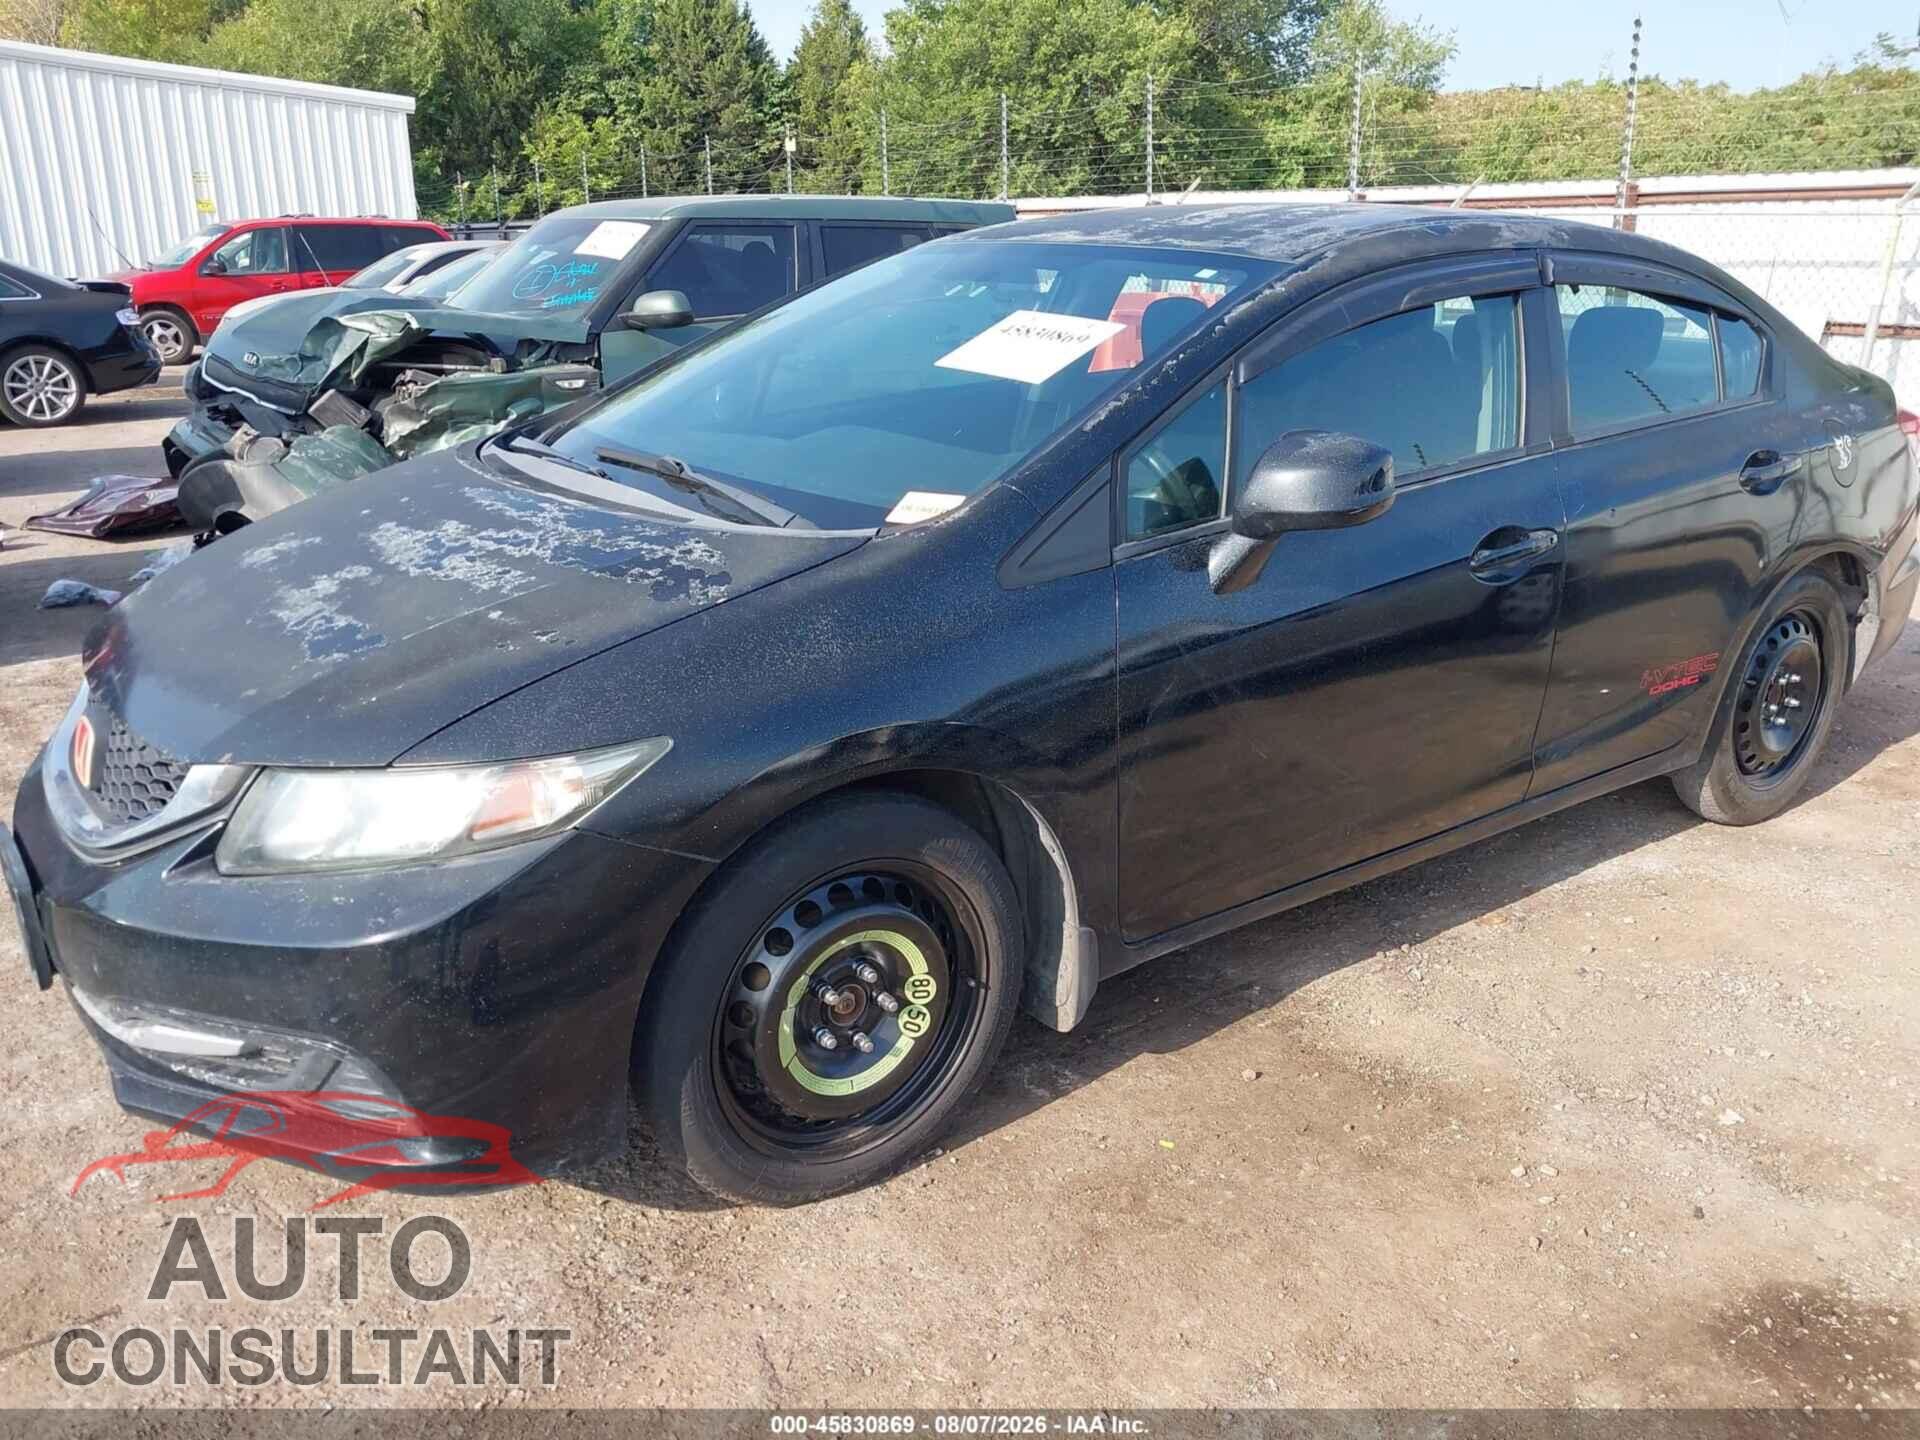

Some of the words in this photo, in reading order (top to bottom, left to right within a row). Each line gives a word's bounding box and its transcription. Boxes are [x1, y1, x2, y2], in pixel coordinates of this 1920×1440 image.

[1648, 675, 1700, 696] DOHC
[911, 978, 931, 999] 80
[903, 1008, 927, 1033] 50
